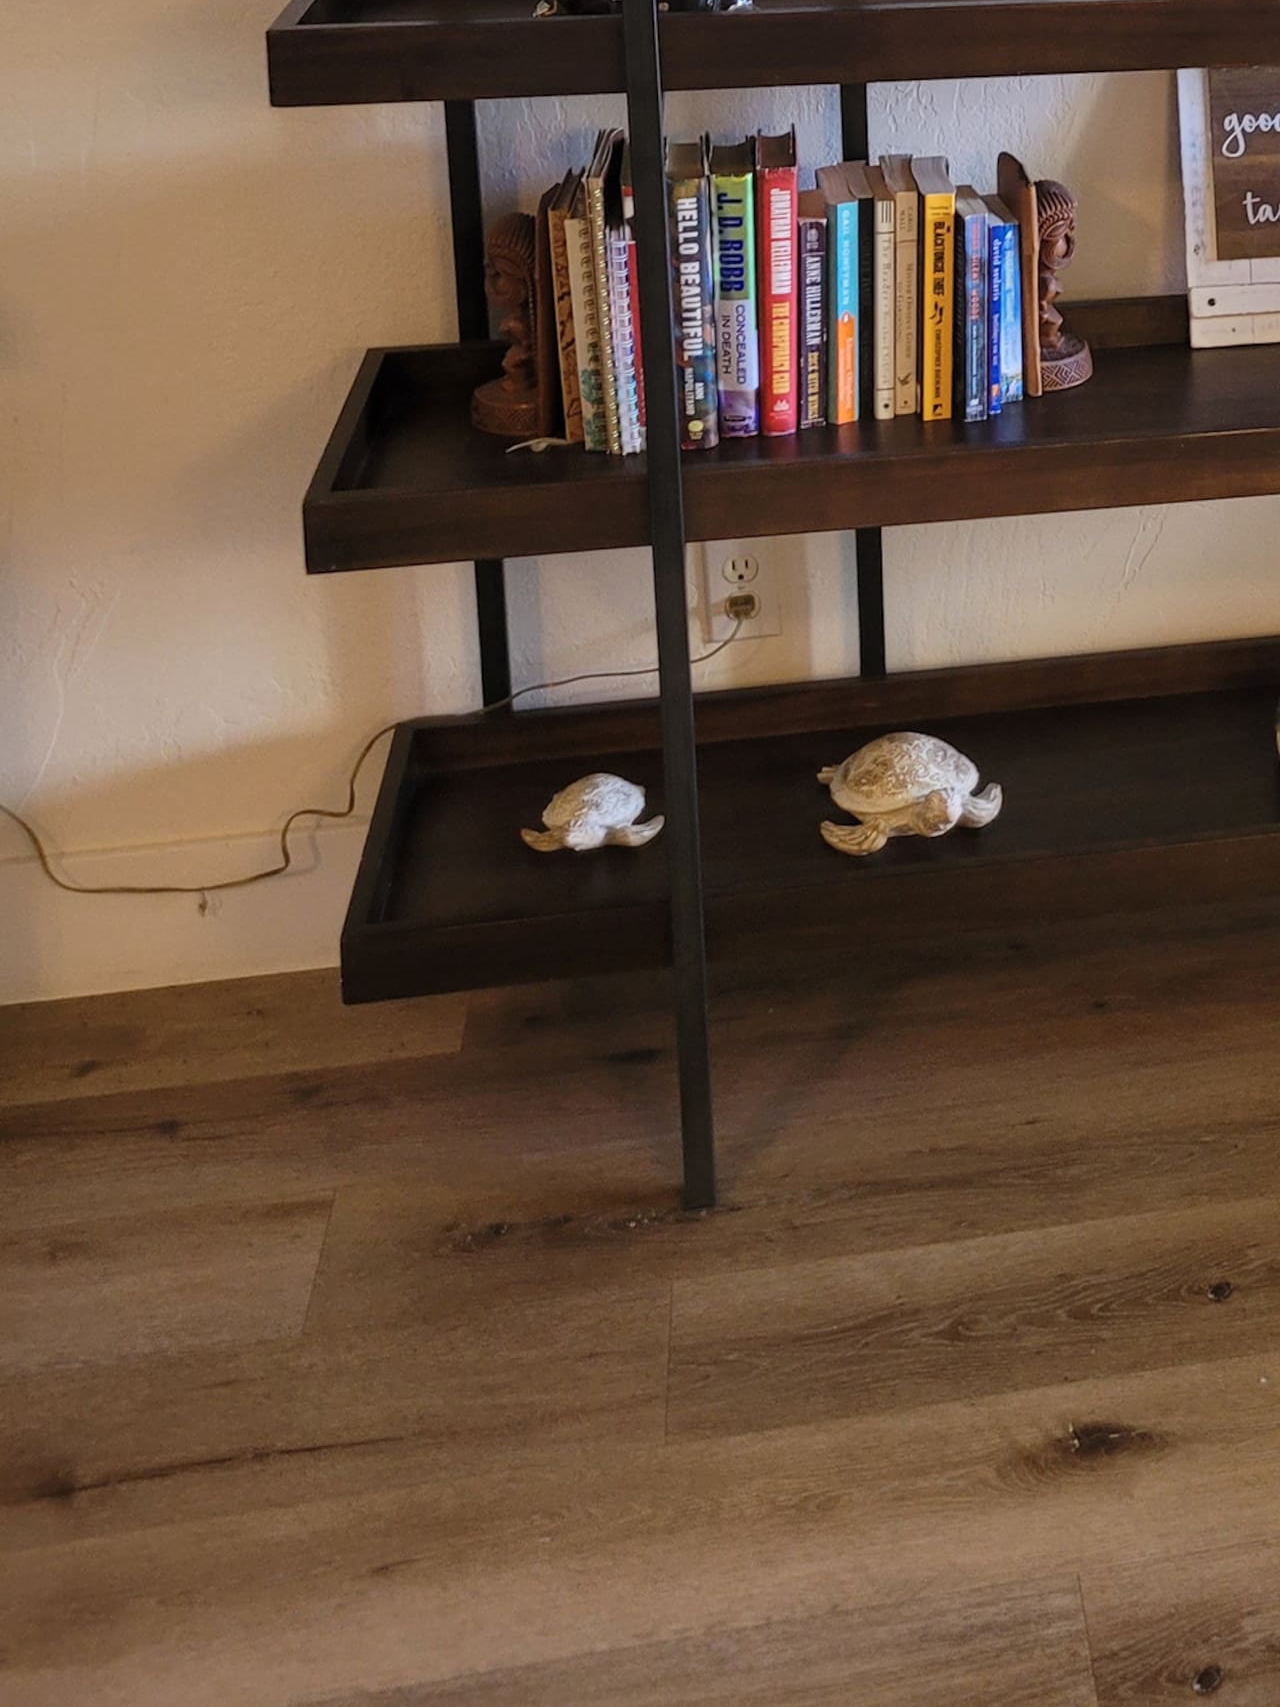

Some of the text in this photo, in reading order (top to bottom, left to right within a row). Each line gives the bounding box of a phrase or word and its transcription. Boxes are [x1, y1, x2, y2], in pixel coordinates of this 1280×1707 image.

[677, 196, 704, 361] HELLO BEAUTIFUL
[717, 191, 745, 292] J. D. ROBB
[770, 188, 792, 294] JONATHAN KELLERMAN
[841, 210, 851, 306] GAIL HONEYMAN
[932, 221, 946, 275] BLACKTONGUE
[992, 238, 1003, 265] david
[772, 301, 791, 318] THE
[806, 256, 823, 346] ANNE HILLERMAN
[933, 277, 946, 297] THIEF
[720, 314, 733, 373] IN DEATH
[734, 304, 747, 384] CONCEALED
